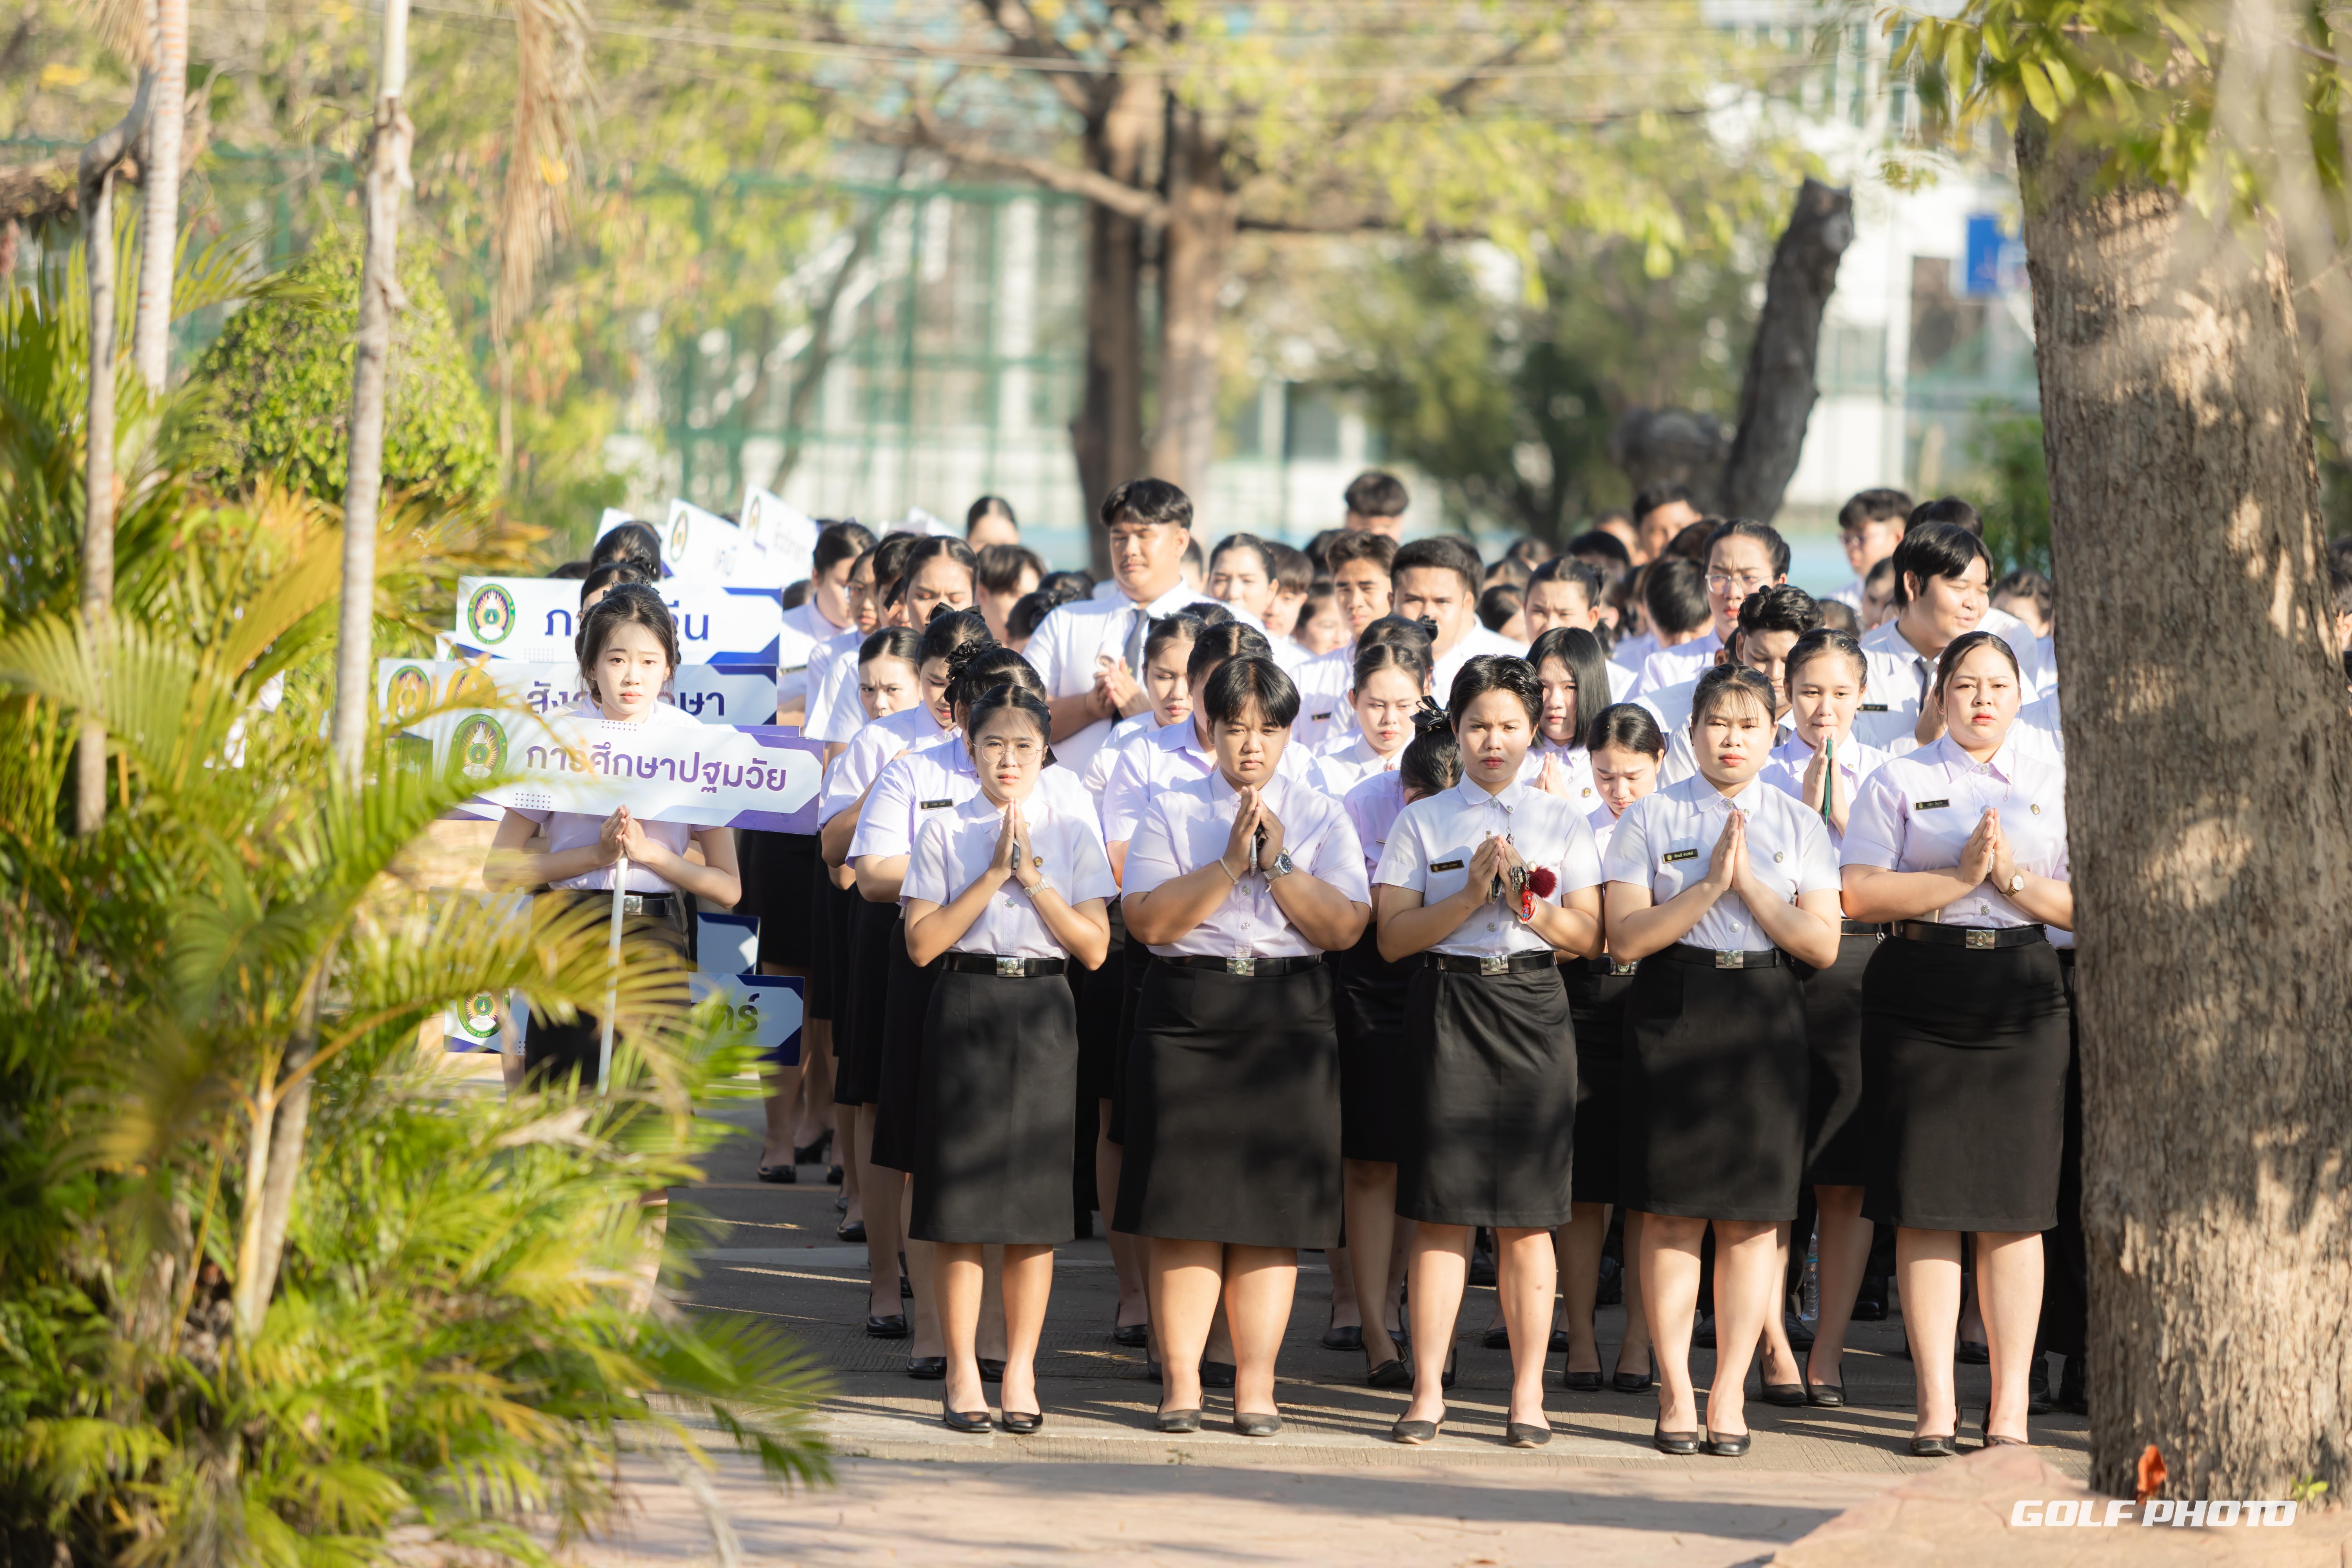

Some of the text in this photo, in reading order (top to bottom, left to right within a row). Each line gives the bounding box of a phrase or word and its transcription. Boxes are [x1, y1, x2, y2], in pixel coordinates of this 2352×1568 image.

[526, 742, 787, 793] การศึกษาปฐมวัย
